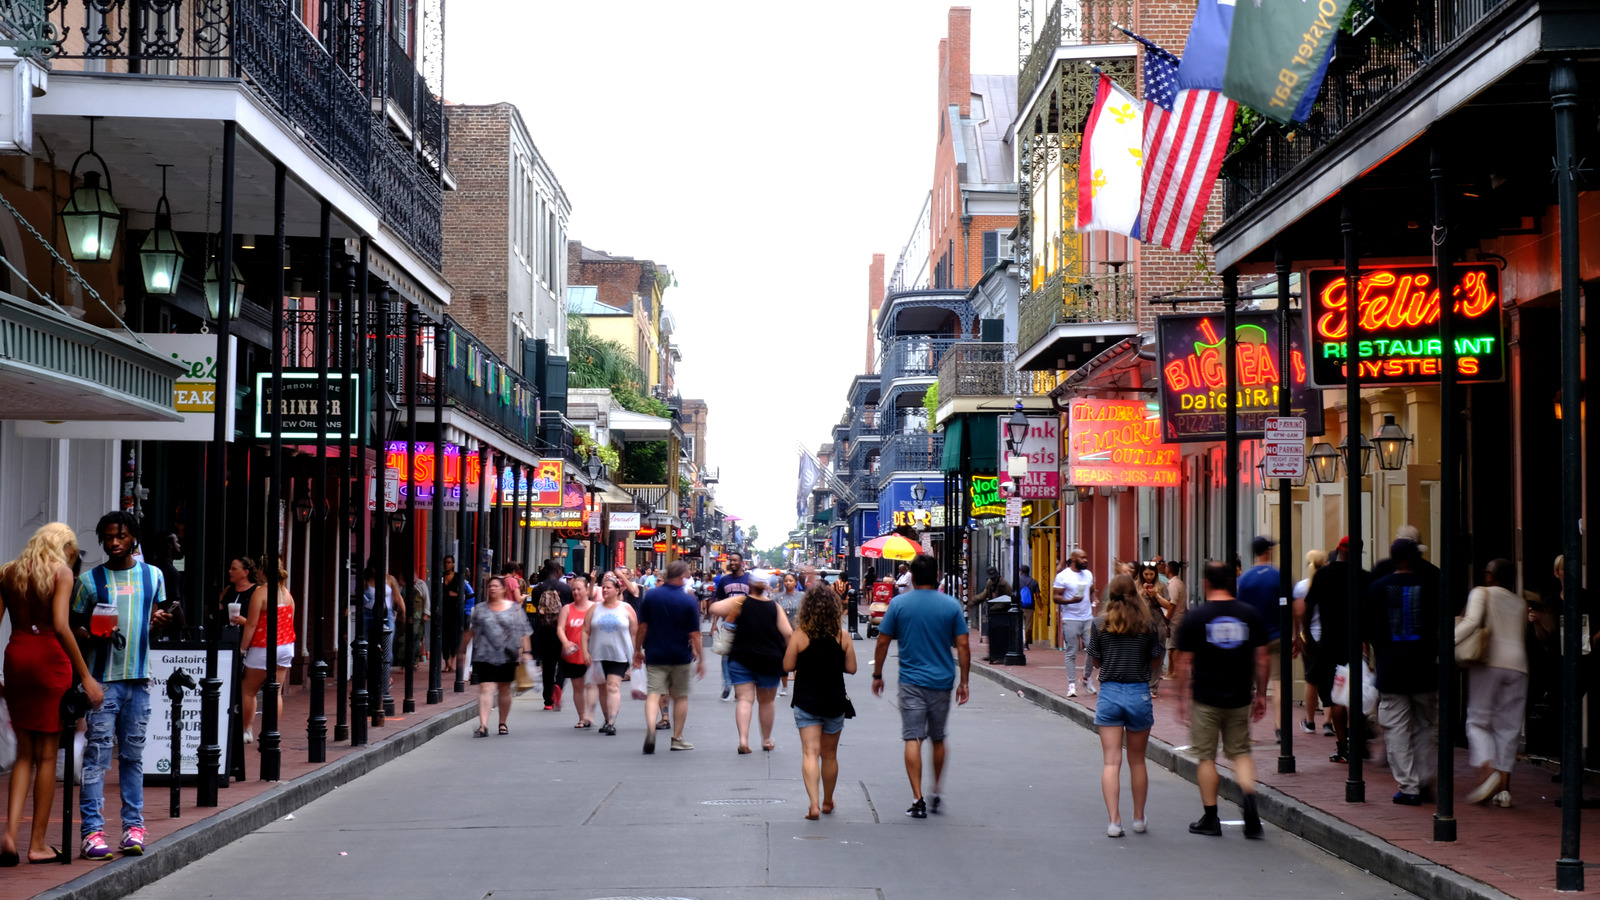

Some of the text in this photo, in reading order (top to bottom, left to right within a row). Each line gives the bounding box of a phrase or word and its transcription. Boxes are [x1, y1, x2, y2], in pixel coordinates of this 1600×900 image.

[1323, 336, 1496, 358] RSTAURNT
[1164, 347, 1227, 391] BIG
[1266, 420, 1303, 430] NO PARKING
[1266, 446, 1303, 455] NO PARKING
[157, 761, 169, 770] 33
